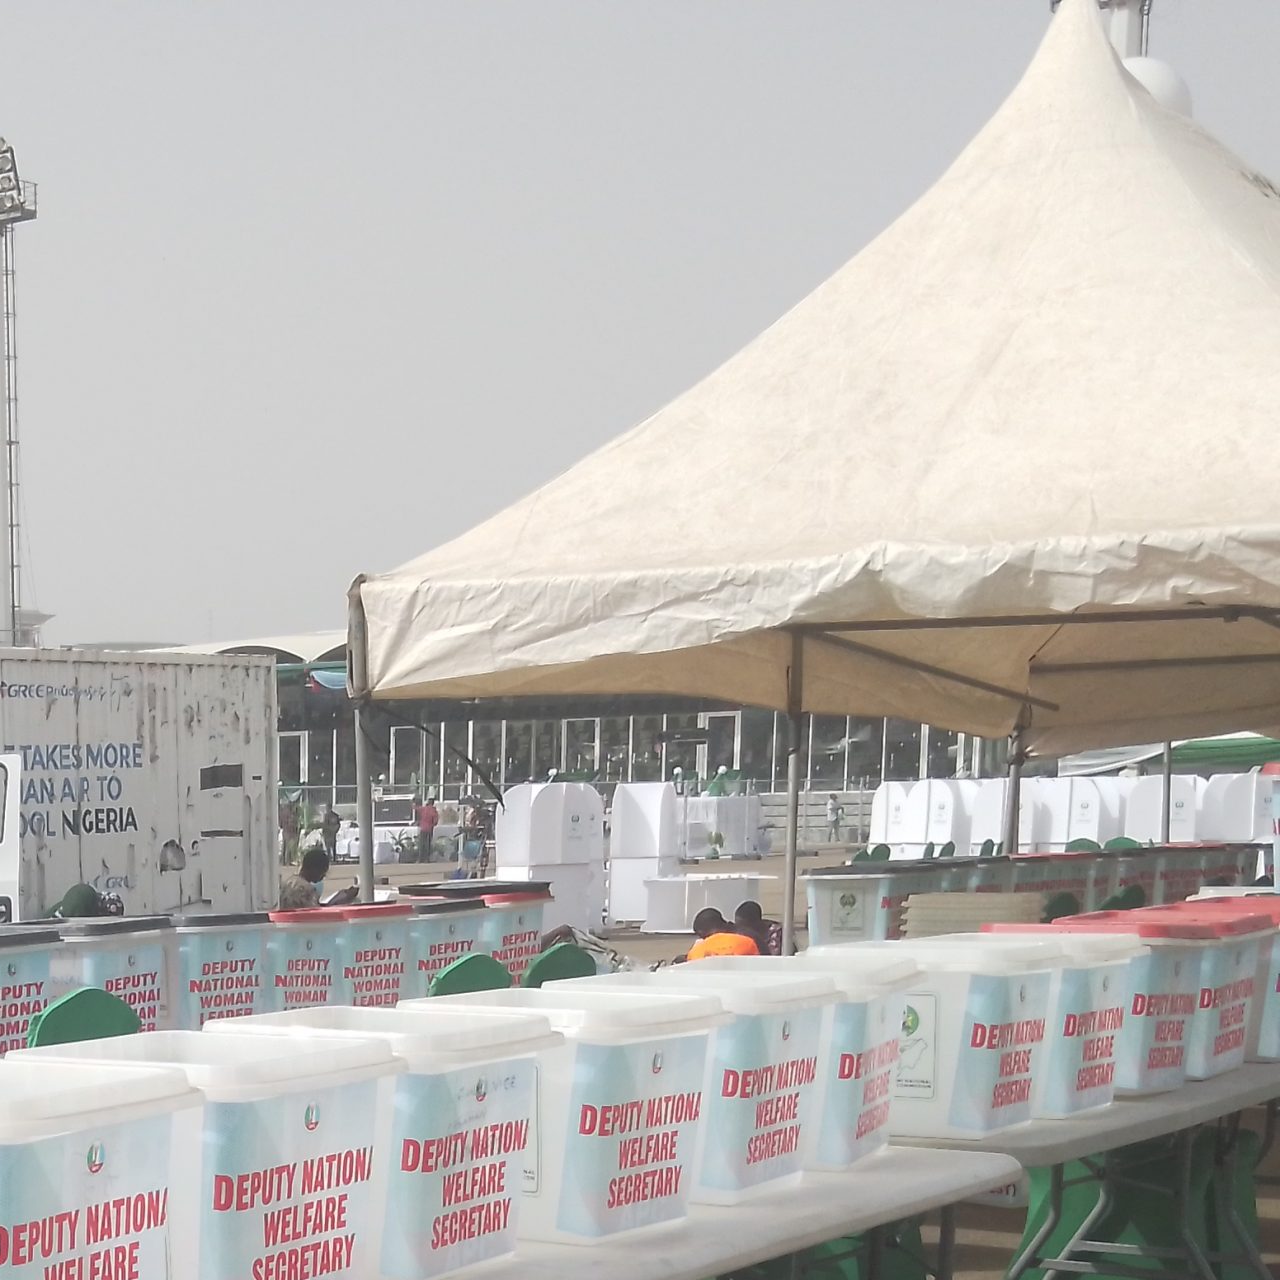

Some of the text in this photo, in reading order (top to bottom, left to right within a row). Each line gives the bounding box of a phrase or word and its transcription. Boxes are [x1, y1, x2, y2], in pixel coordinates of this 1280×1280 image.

[19, 742, 143, 771] TAKES MORE
[20, 775, 122, 804] AN AR TO
[61, 806, 139, 840] NGERIA
[429, 940, 474, 956] DEPUTY
[502, 930, 539, 947] DEPUTY
[202, 958, 256, 976] DEPUTY
[287, 958, 331, 972] DEPUTY
[354, 947, 403, 964] DEPUTY
[418, 955, 461, 971] NATIO
[105, 971, 158, 993] DEPUTY
[274, 974, 333, 988] NATIONAL
[343, 961, 405, 980] NATIONAL
[189, 974, 260, 993] NATIONAL
[353, 977, 401, 994] WOMAN
[199, 991, 255, 1009] WOMAN
[284, 989, 328, 1004] WOMAN
[353, 992, 400, 1009] LEADER
[720, 1064, 774, 1100] DEPUTY
[577, 1098, 643, 1137] DEPUTY
[754, 1092, 801, 1130] WELFARE
[400, 1129, 469, 1174] DEPUTY
[618, 1130, 680, 1171] WELFARE
[745, 1123, 802, 1166] SECRETARY
[211, 1162, 298, 1213] DEPUTY
[441, 1160, 506, 1208] WELFARE
[607, 1164, 683, 1210] SECRETARY
[262, 1192, 349, 1249] WELFARE
[430, 1196, 513, 1252] SECRETARY
